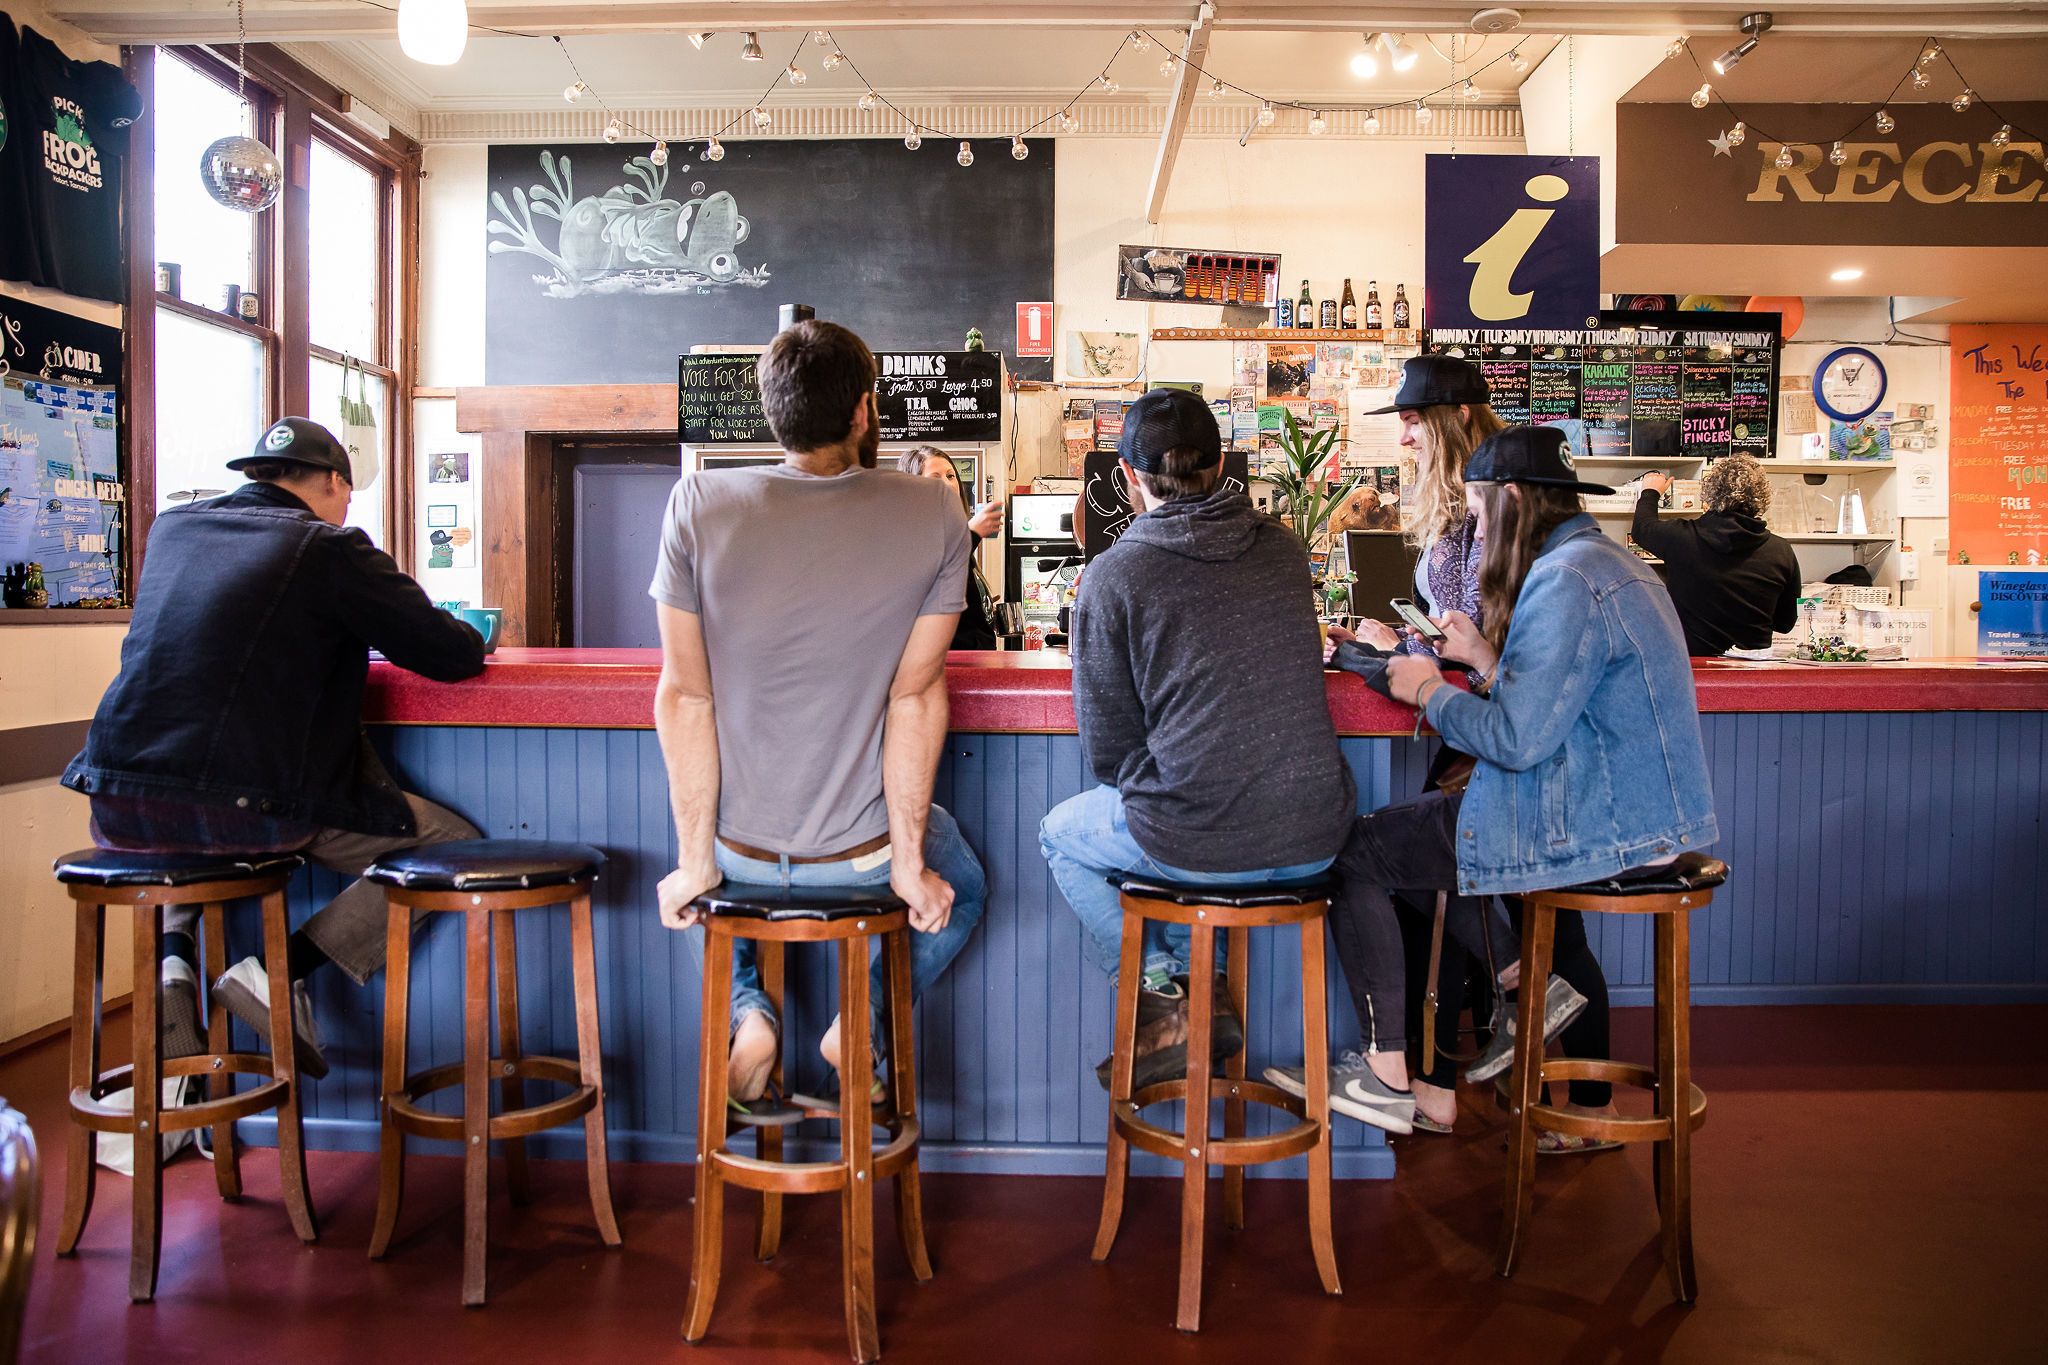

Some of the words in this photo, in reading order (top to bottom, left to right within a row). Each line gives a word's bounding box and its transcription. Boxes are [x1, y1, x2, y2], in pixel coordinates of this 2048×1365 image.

[43, 130, 102, 175] FROG
[1746, 141, 2048, 204] RECE
[1463, 174, 1570, 321] i
[1432, 328, 1480, 344] MONDAY
[1482, 330, 1532, 344] TUESDAY
[1532, 330, 1582, 344] WEDNESDAY
[1584, 330, 1635, 344] THURSDAY
[1634, 332, 1676, 346] FRIDAY
[1684, 332, 1734, 346] SATURDAY
[1734, 332, 1770, 346] SUNDAY
[64, 346, 102, 373] CIDER
[882, 355, 946, 376] DRINKS
[1963, 343, 2002, 376] This
[683, 369, 710, 387] VOTE
[714, 366, 743, 392] FOR
[738, 365, 758, 384] TH
[1584, 364, 1629, 378] KARAOKE
[681, 390, 696, 404] YOU
[700, 391, 717, 402] WILL
[721, 392, 735, 401] GET
[1997, 380, 2024, 401] The
[679, 404, 712, 418] DRINK!
[716, 403, 746, 416] PLEASE
[904, 397, 929, 410] TEA
[1995, 405, 2013, 414] FREE
[685, 418, 707, 428] STAFF
[711, 417, 724, 428] FOR
[748, 419, 769, 427] DETA
[1683, 416, 1726, 432] STICKY
[710, 429, 728, 440] YUM
[733, 429, 754, 440] YUM!
[1684, 430, 1730, 444] FINGERS
[2003, 456, 2026, 465] FREE
[54, 478, 95, 498] GINGER
[96, 481, 124, 502] BEER
[2000, 497, 2031, 510] FREE
[78, 534, 106, 553] WINE
[1990, 581, 2048, 593] Wineglass
